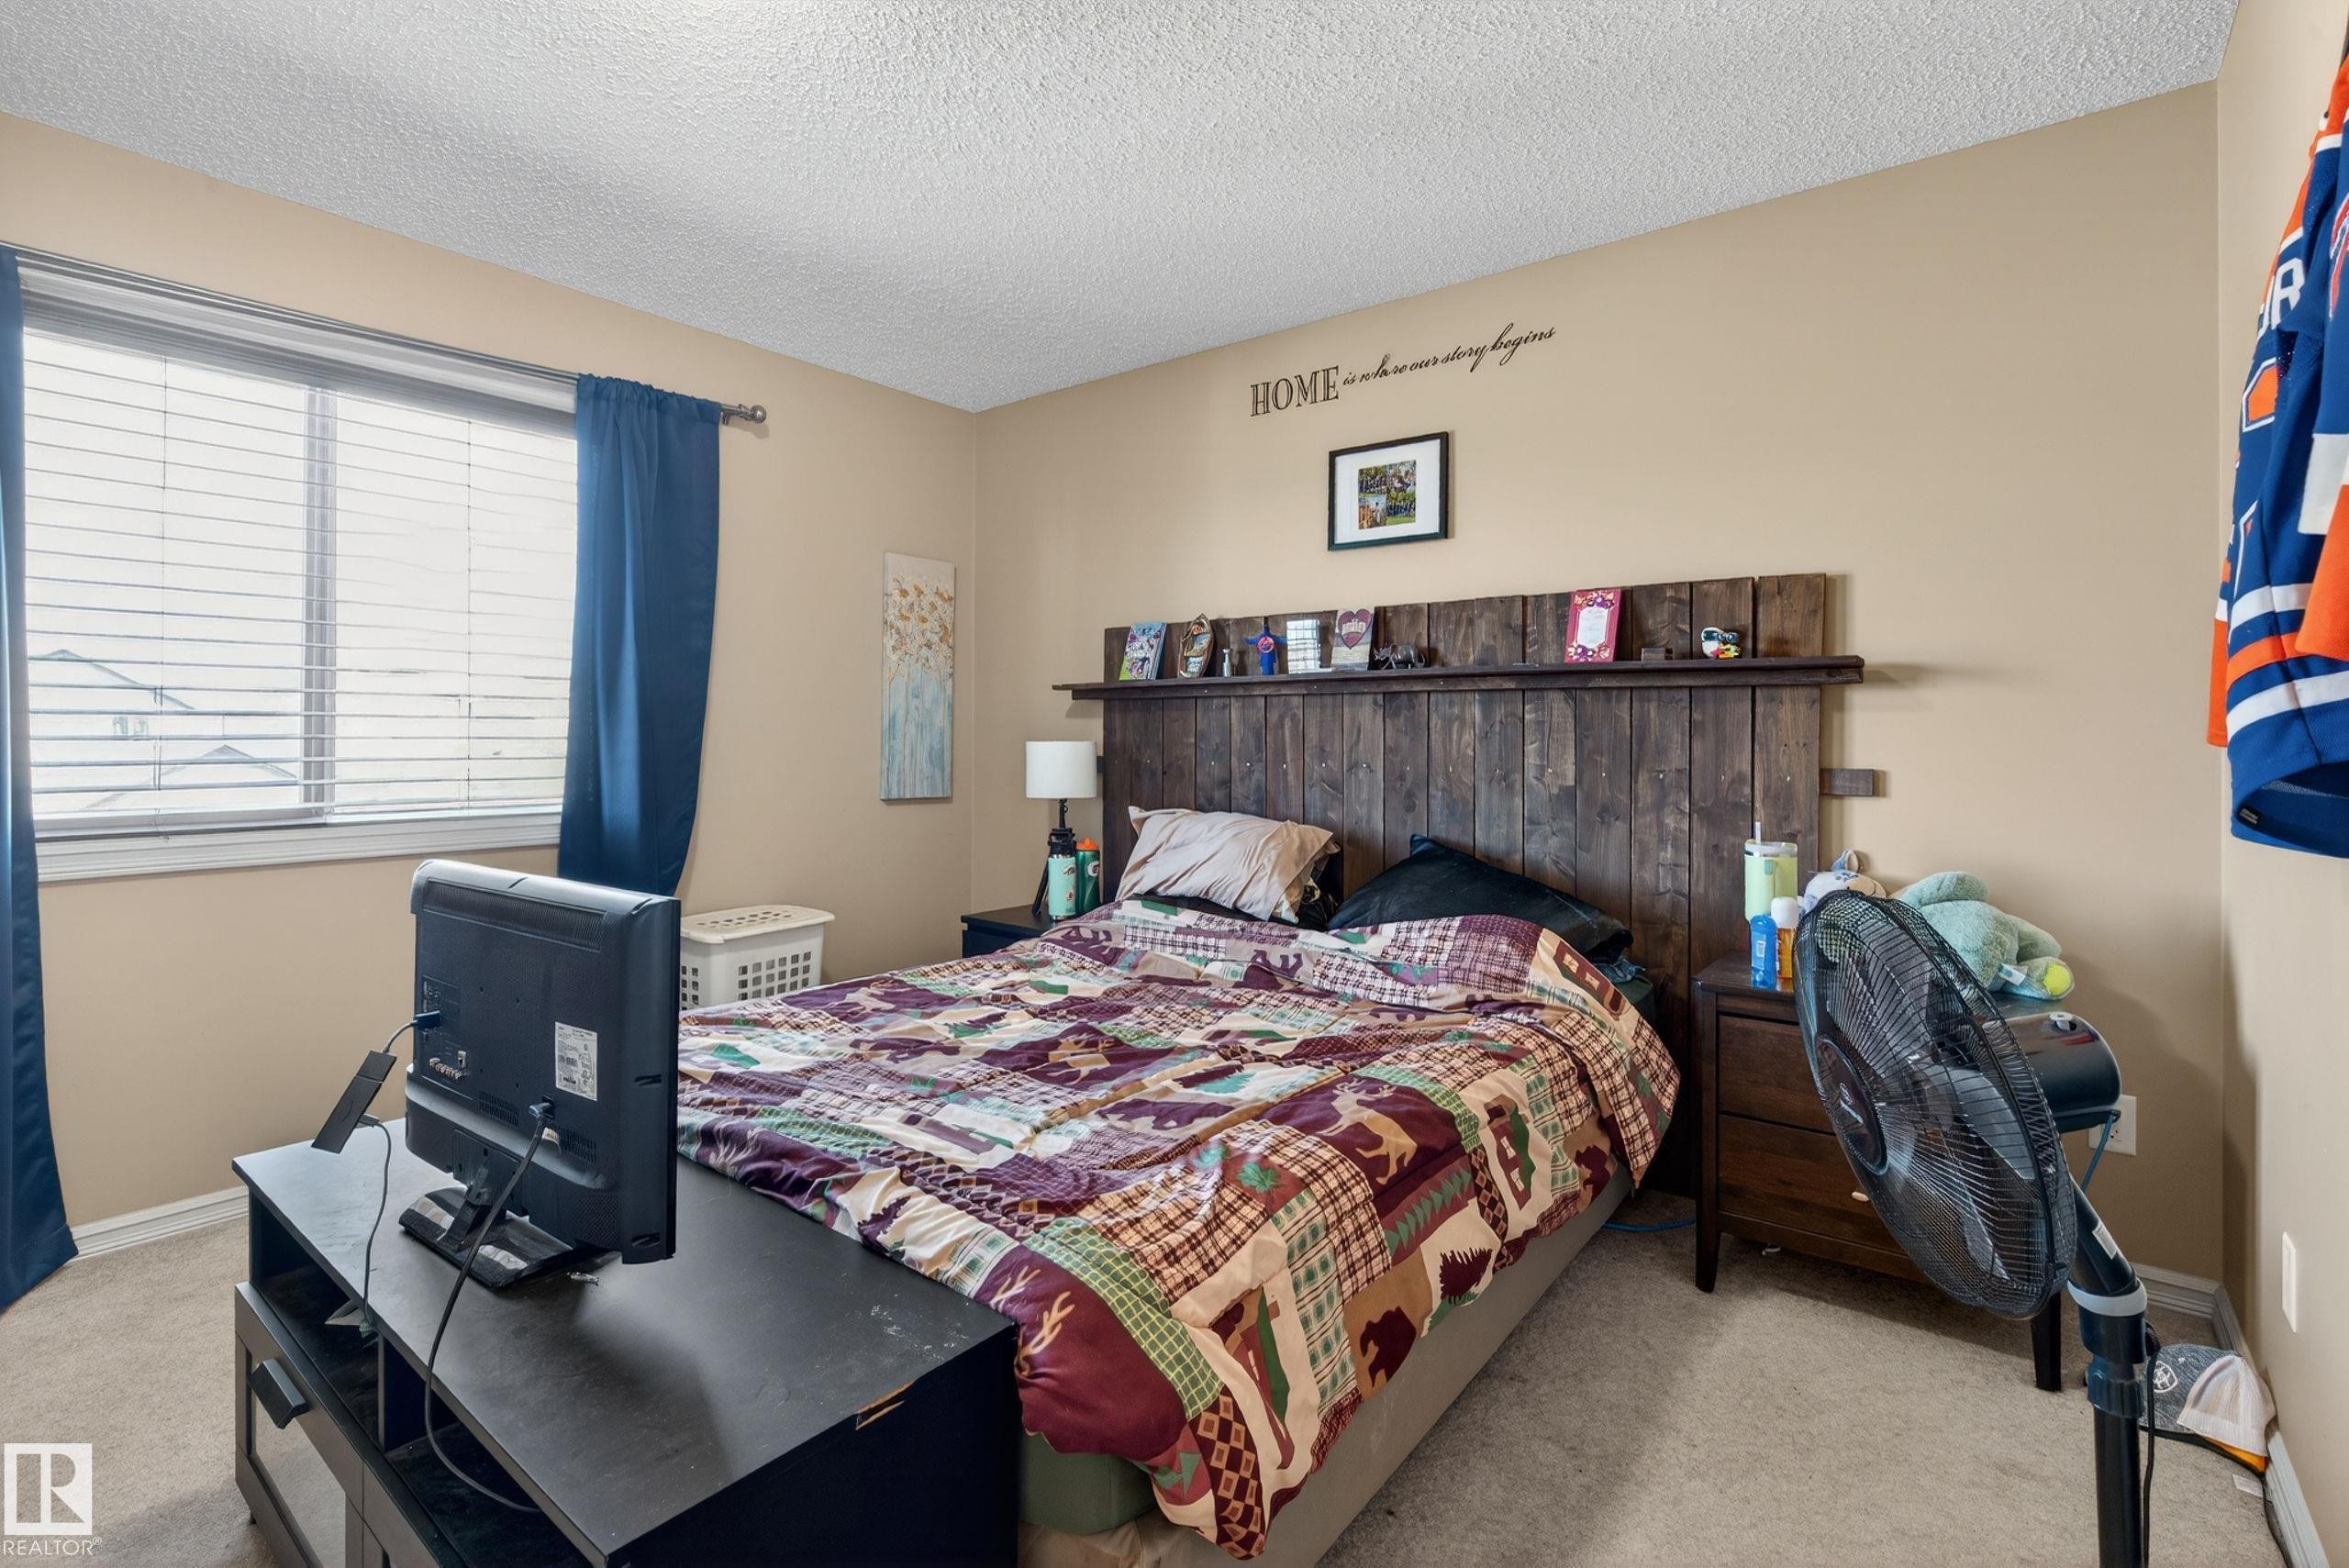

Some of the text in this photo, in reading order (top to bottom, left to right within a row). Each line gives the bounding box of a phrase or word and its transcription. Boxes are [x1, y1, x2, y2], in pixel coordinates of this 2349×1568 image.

[1250, 365, 1339, 417] HOME
[1342, 372, 1356, 385] is
[1409, 356, 1439, 372] our
[1441, 345, 1488, 373] story
[1488, 322, 1555, 366] begins
